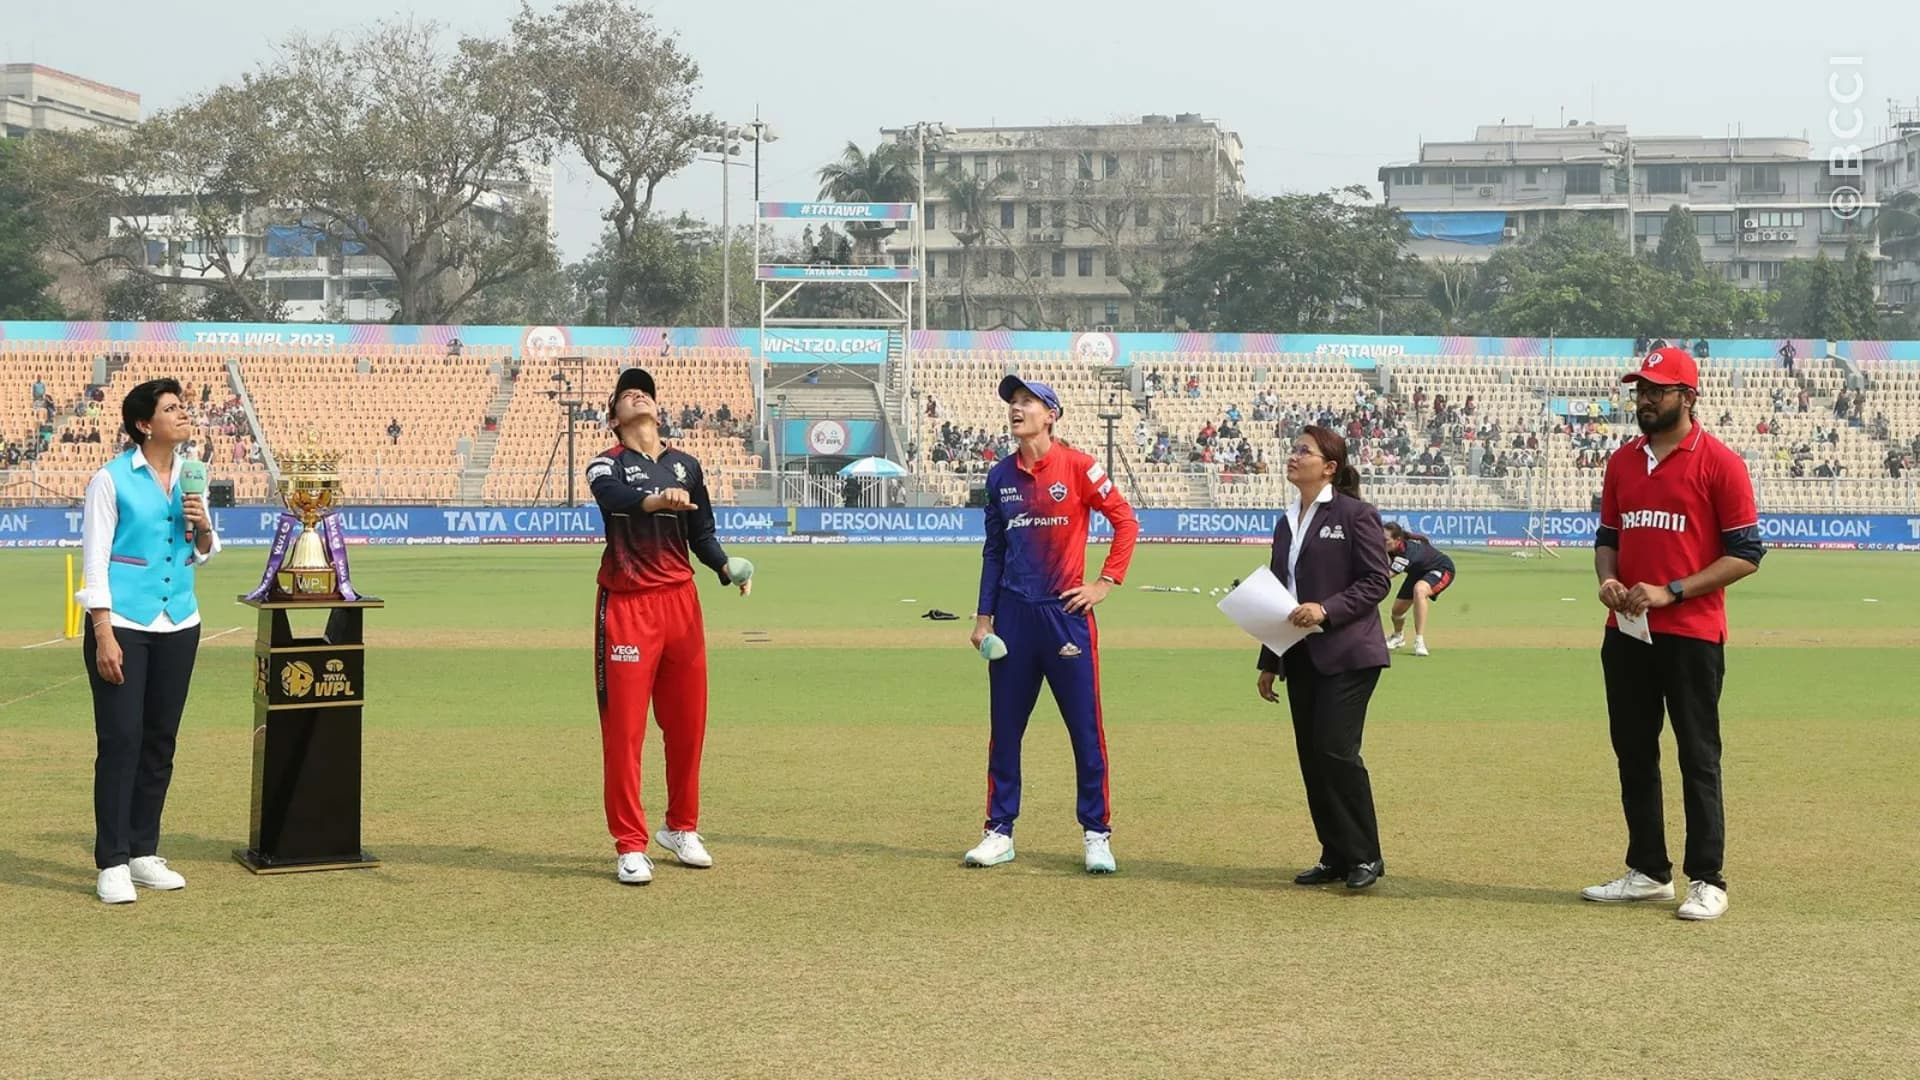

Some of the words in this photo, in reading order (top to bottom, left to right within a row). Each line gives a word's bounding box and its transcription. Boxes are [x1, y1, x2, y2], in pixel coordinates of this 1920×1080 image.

[800, 205, 873, 217] #TATAWPL
[195, 331, 239, 344] TATA
[244, 332, 283, 346] WPL
[289, 333, 335, 347] 2023
[764, 337, 882, 353] WPLT20.COM
[0, 514, 27, 532] AN
[361, 512, 408, 530] LOAN
[443, 511, 508, 532] TATA
[514, 511, 595, 532] CAPITAL
[725, 512, 772, 530] LOAN
[821, 512, 914, 530] PERSONAL
[917, 513, 963, 530] LOAN
[1034, 516, 1069, 526] PAINTS
[1178, 514, 1271, 532] PERSONAL
[1418, 515, 1497, 535] CAPITAL
[1529, 516, 1601, 535] PERSON
[1758, 518, 1818, 537] SONAL
[1821, 519, 1870, 537] LOAN
[297, 577, 328, 590] WPL
[611, 645, 640, 655] VEGA
[323, 673, 347, 682] TATA
[315, 681, 355, 697] WPL
